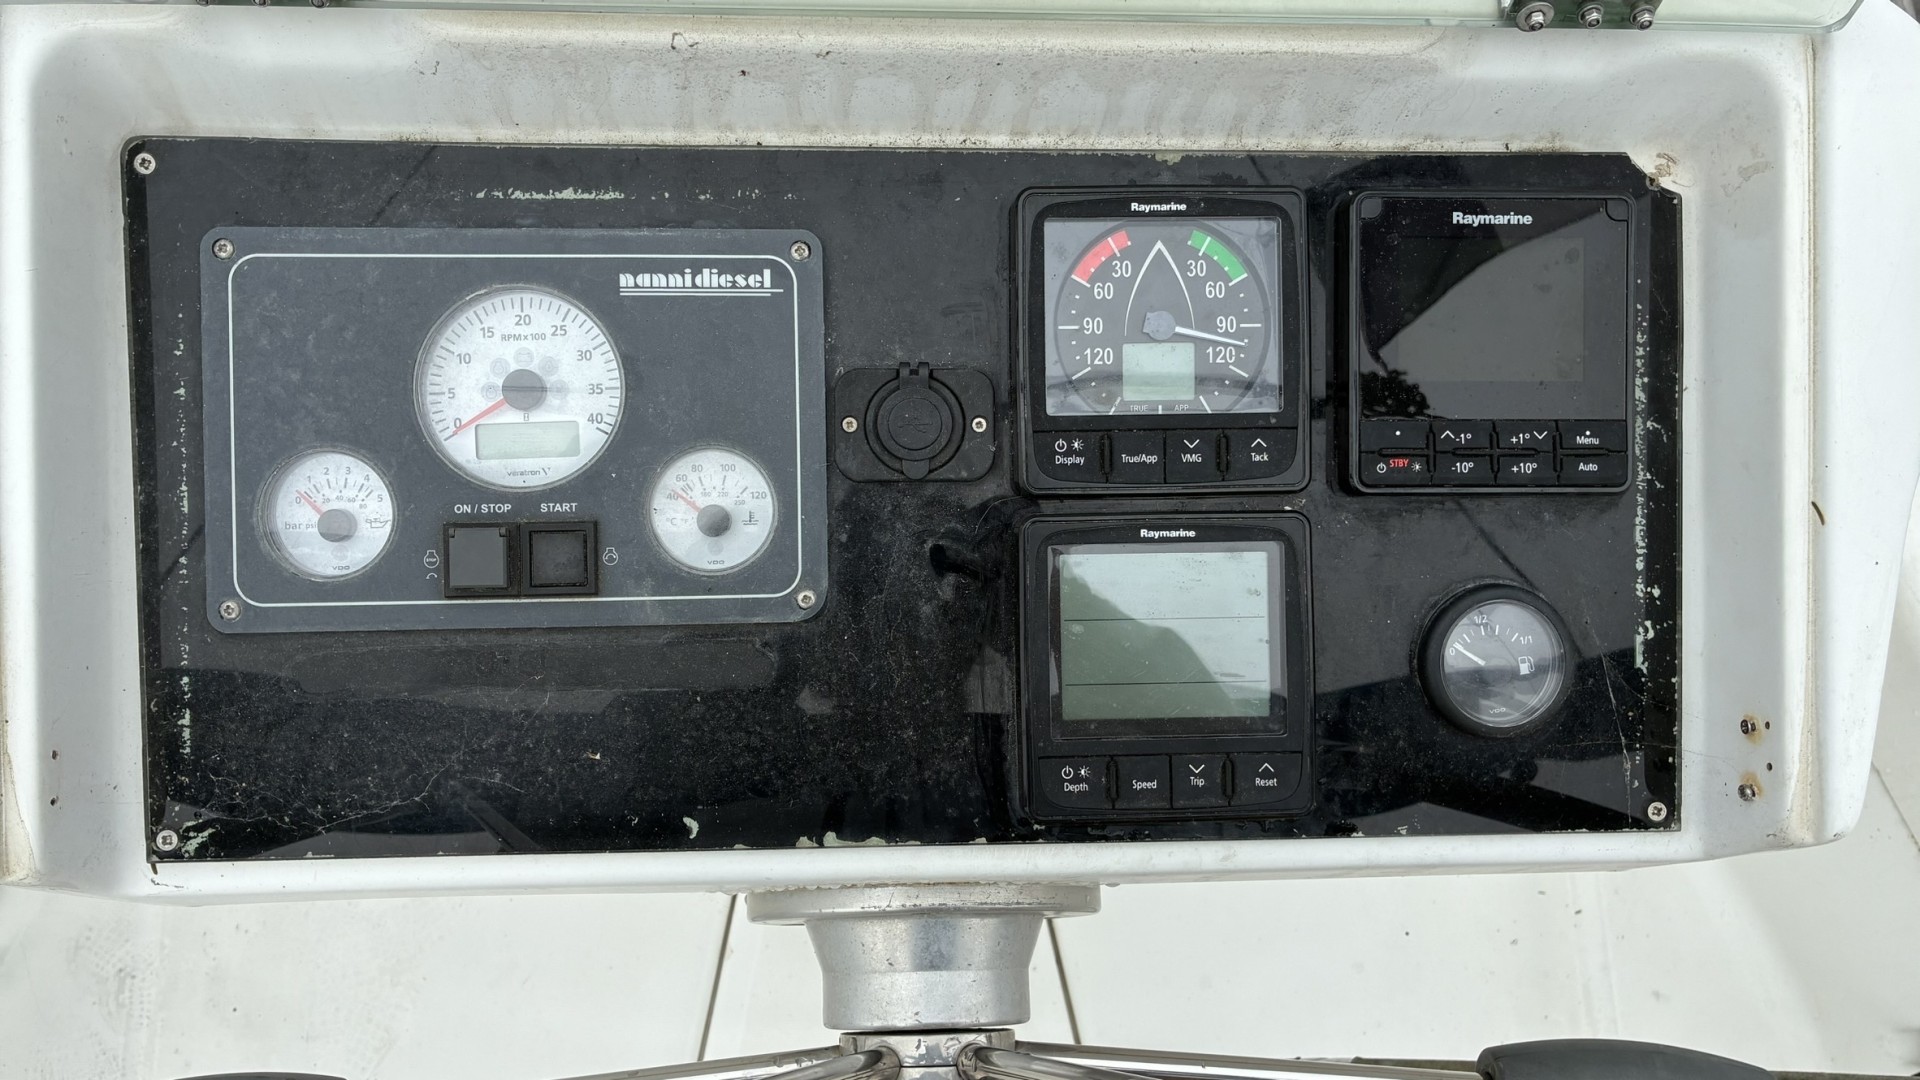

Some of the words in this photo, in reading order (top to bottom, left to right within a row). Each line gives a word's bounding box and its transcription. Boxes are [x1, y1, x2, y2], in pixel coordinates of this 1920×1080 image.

[1131, 202, 1187, 213] Raymarine
[1452, 211, 1533, 227] Raymarine
[1112, 260, 1132, 278] 30
[1187, 259, 1207, 277] 30
[1094, 282, 1114, 300] 60
[1205, 281, 1225, 299] 60
[514, 314, 531, 326] 20
[1216, 316, 1236, 333] 90
[1083, 317, 1103, 334] 90
[480, 327, 494, 339] 15
[550, 325, 567, 337] 25
[456, 353, 472, 365] 10
[576, 350, 592, 361] 30
[1084, 348, 1114, 365] 120
[1206, 346, 1236, 363] 120
[447, 388, 455, 399] 5
[588, 383, 603, 395] 35
[1174, 404, 1189, 412] APP
[454, 417, 462, 429] 0
[587, 413, 603, 425] 40
[1576, 436, 1599, 445] Menu
[1055, 454, 1085, 466] Display
[1121, 453, 1158, 463] True/App
[1181, 453, 1202, 463] VMG
[1251, 452, 1269, 462] Tack
[720, 463, 736, 472] 100
[1390, 458, 1409, 467] STBY
[1579, 462, 1598, 471] Auto
[323, 467, 330, 475] 2
[345, 466, 351, 475] 3
[507, 469, 541, 477] veratron
[691, 464, 703, 473] 80
[363, 474, 370, 482] 4
[675, 474, 688, 482] 60
[295, 496, 302, 505] 0
[377, 494, 383, 502] 5
[750, 491, 767, 500] 120
[454, 504, 472, 514] ON
[481, 504, 512, 513] STOP
[540, 503, 578, 512] START
[284, 521, 302, 530] bar
[305, 522, 317, 530] psi
[1140, 529, 1196, 539] Raymarine
[1474, 614, 1487, 623] 1/2
[1520, 635, 1533, 644] 1/1
[1132, 780, 1157, 790] Speed
[1190, 777, 1205, 786] Trip
[1255, 777, 1277, 786] Reset
[1063, 782, 1089, 793] Depth
